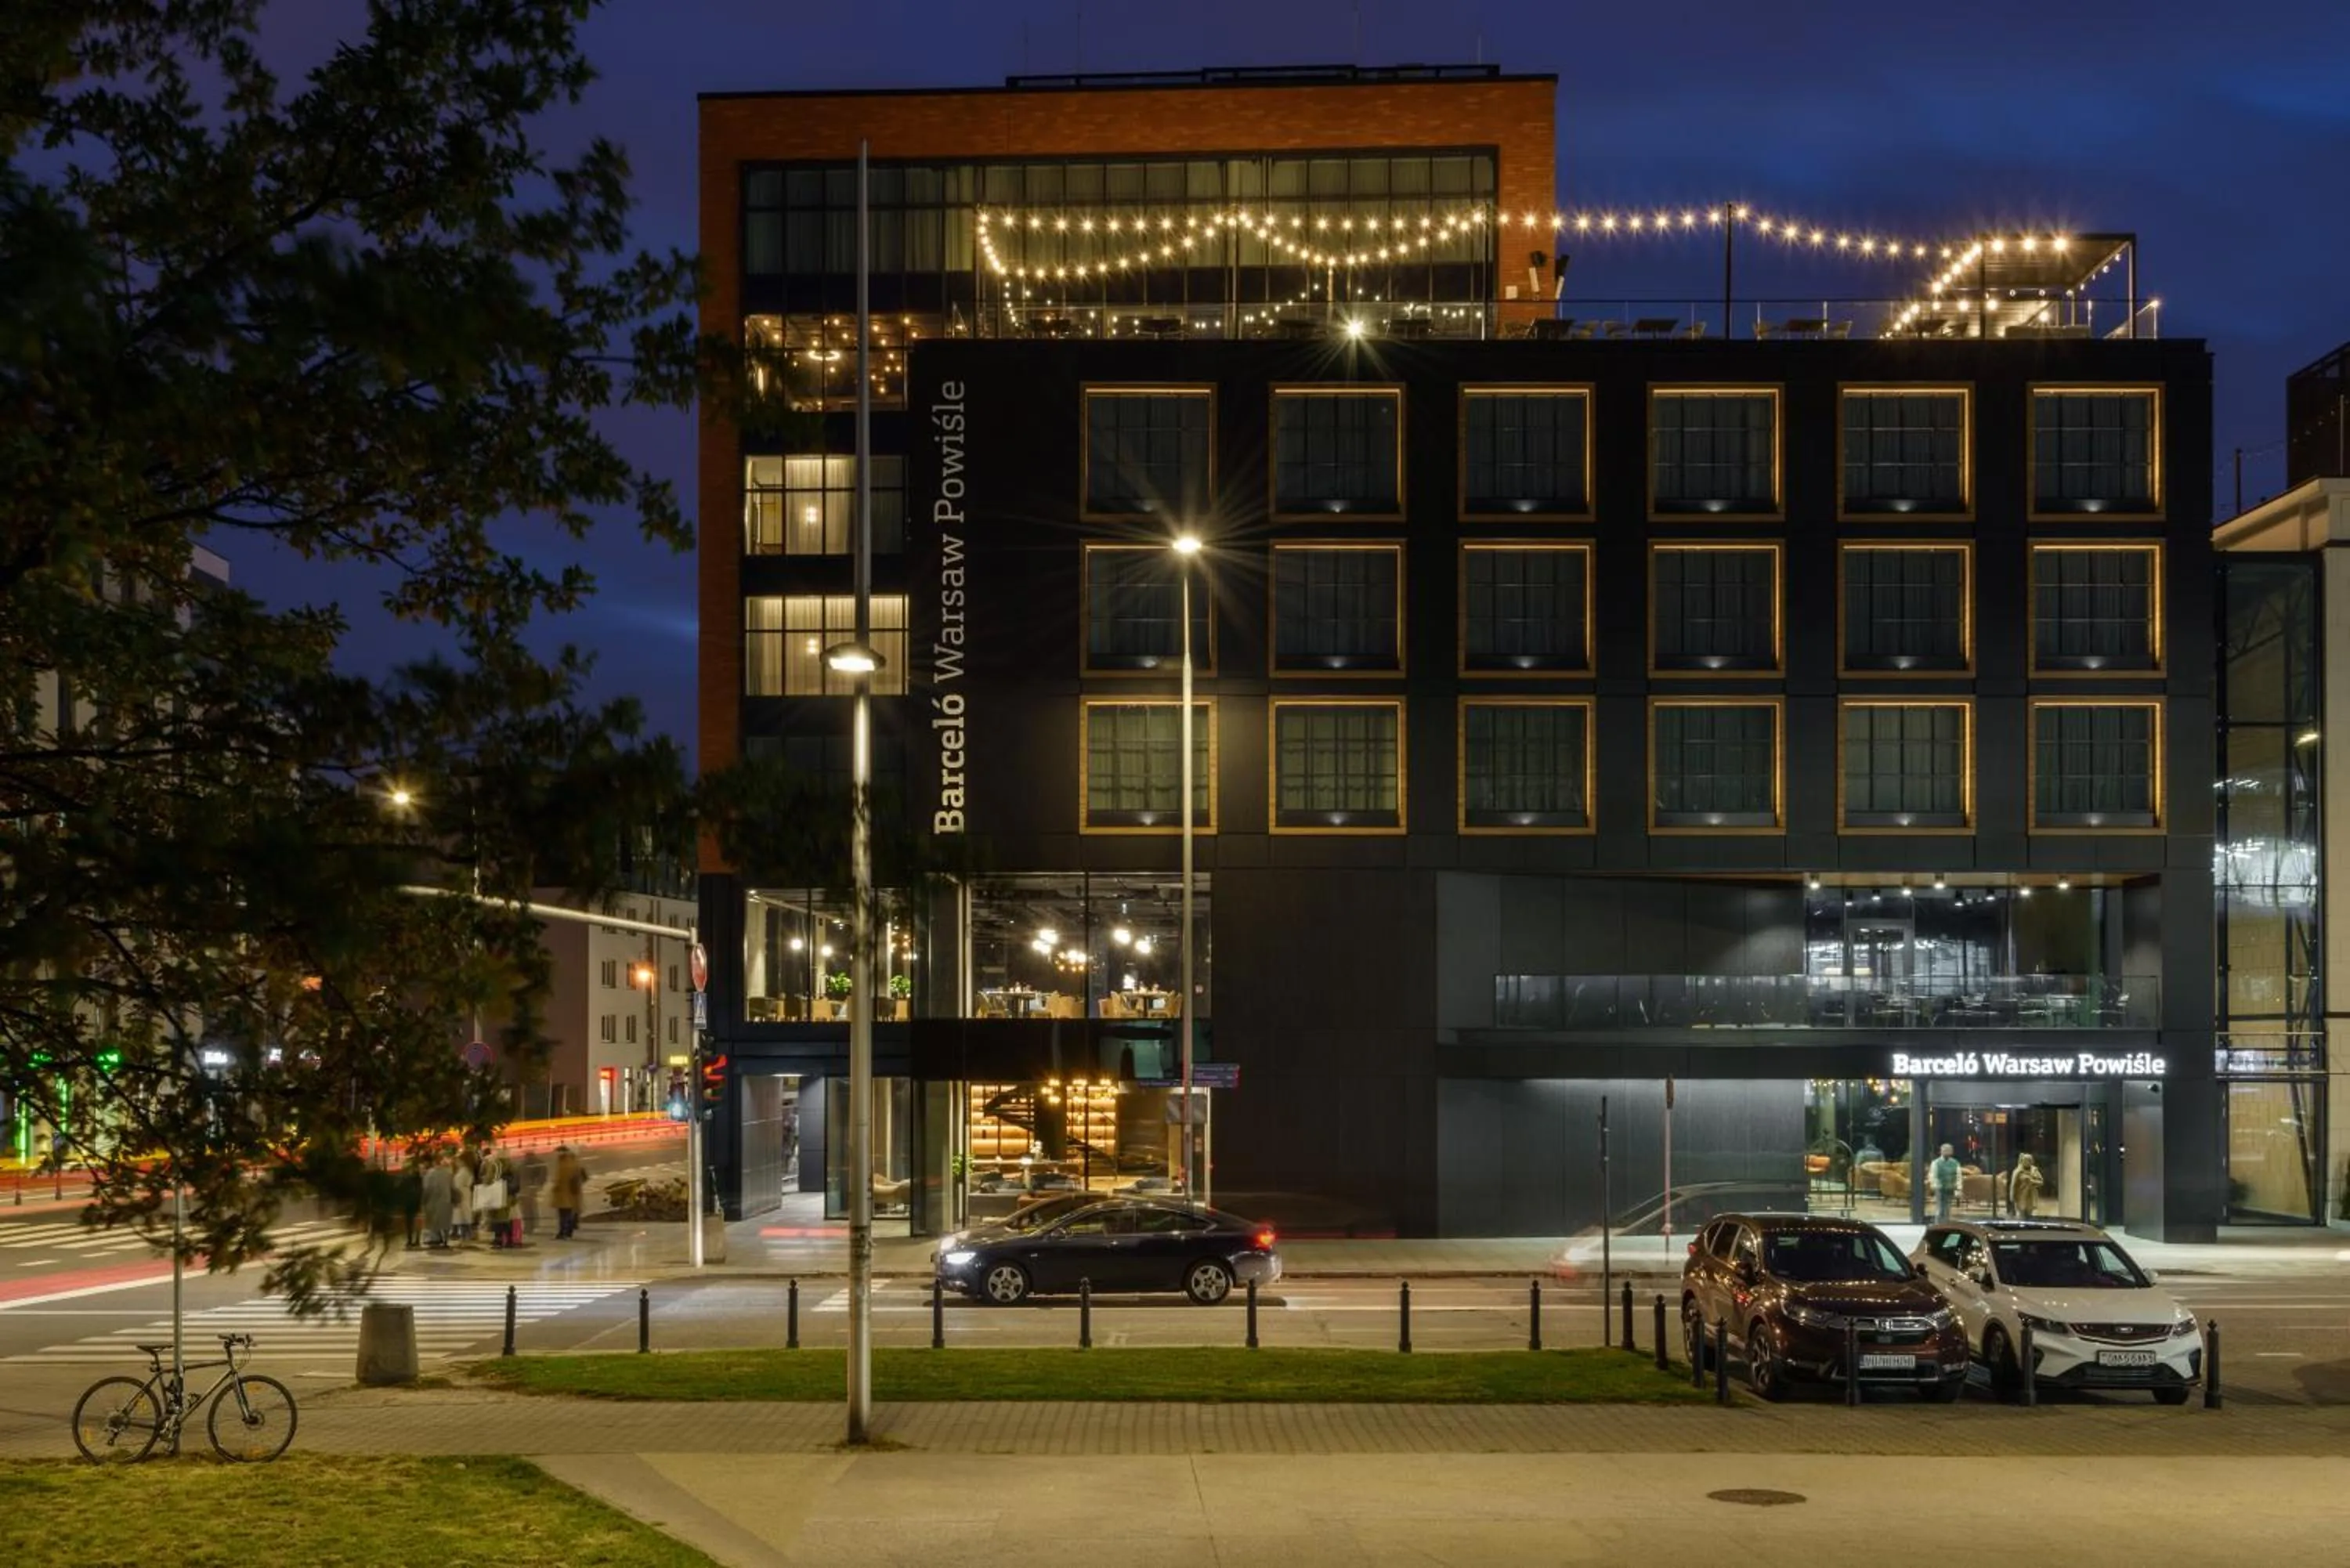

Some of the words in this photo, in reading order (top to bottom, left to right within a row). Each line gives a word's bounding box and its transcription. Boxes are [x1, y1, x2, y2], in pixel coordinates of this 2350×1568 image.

[931, 380, 965, 524] Powiśle
[933, 533, 965, 684] Warsaw
[931, 693, 965, 835] Barceló
[1892, 1052, 1979, 1075] Barceló
[1982, 1053, 2075, 1075] Warsaw
[2077, 1052, 2166, 1075] Powiśle
